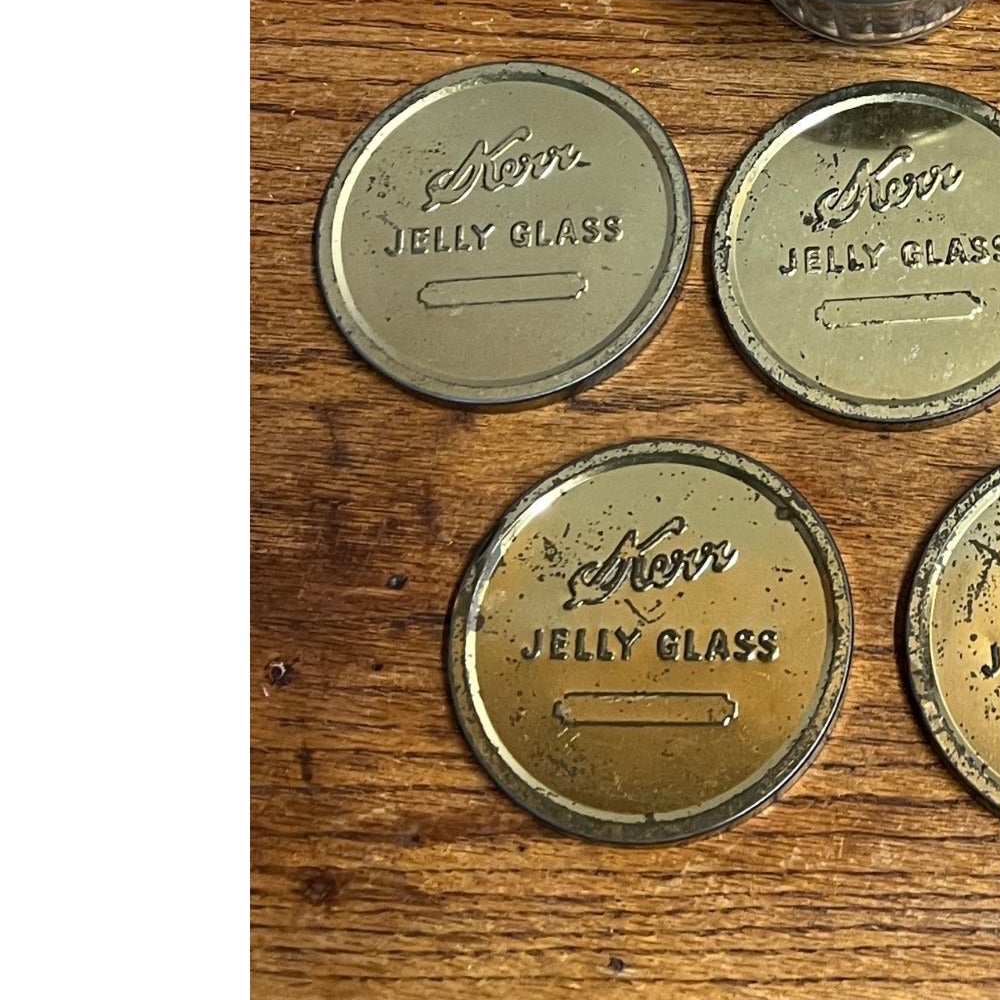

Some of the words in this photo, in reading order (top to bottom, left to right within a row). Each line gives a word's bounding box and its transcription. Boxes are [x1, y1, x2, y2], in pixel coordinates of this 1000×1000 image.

[421, 126, 583, 212] Kerr
[811, 145, 964, 232] Kerr
[384, 223, 496, 257] JELLY
[509, 215, 625, 249] GLASS
[778, 243, 886, 276] JELLY
[562, 516, 739, 611] Kerr
[521, 626, 642, 662] JELLY
[656, 628, 780, 663] GLASS
